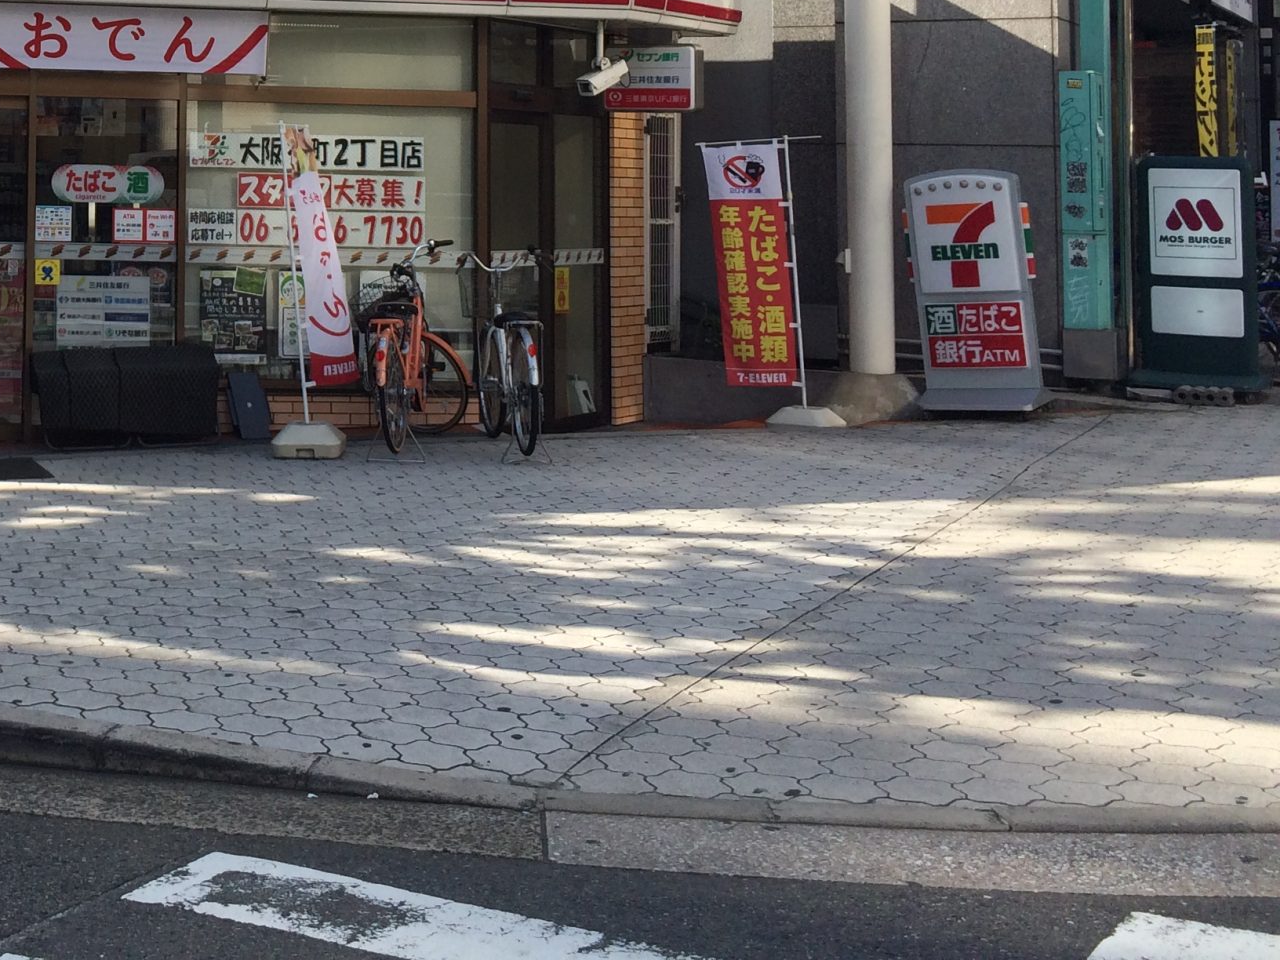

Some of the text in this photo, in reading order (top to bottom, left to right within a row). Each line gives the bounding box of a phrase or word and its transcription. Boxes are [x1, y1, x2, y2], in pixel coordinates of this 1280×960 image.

[22, 12, 217, 64] おでん
[636, 52, 680, 62] セブン銀行
[630, 75, 680, 84] 三井住友銀行
[240, 136, 422, 169] 大阪町2丁目店
[66, 170, 116, 192] たばこ
[126, 171, 149, 193] 酒
[190, 211, 234, 225] 時間応相談
[240, 211, 423, 245] 06-66-7730
[1159, 234, 1232, 245] MOS BURGER
[719, 204, 755, 364] 年齢確認実施中
[747, 205, 789, 365] たばこ・酒類
[928, 306, 955, 334] 酒
[958, 304, 1020, 332] たばこ
